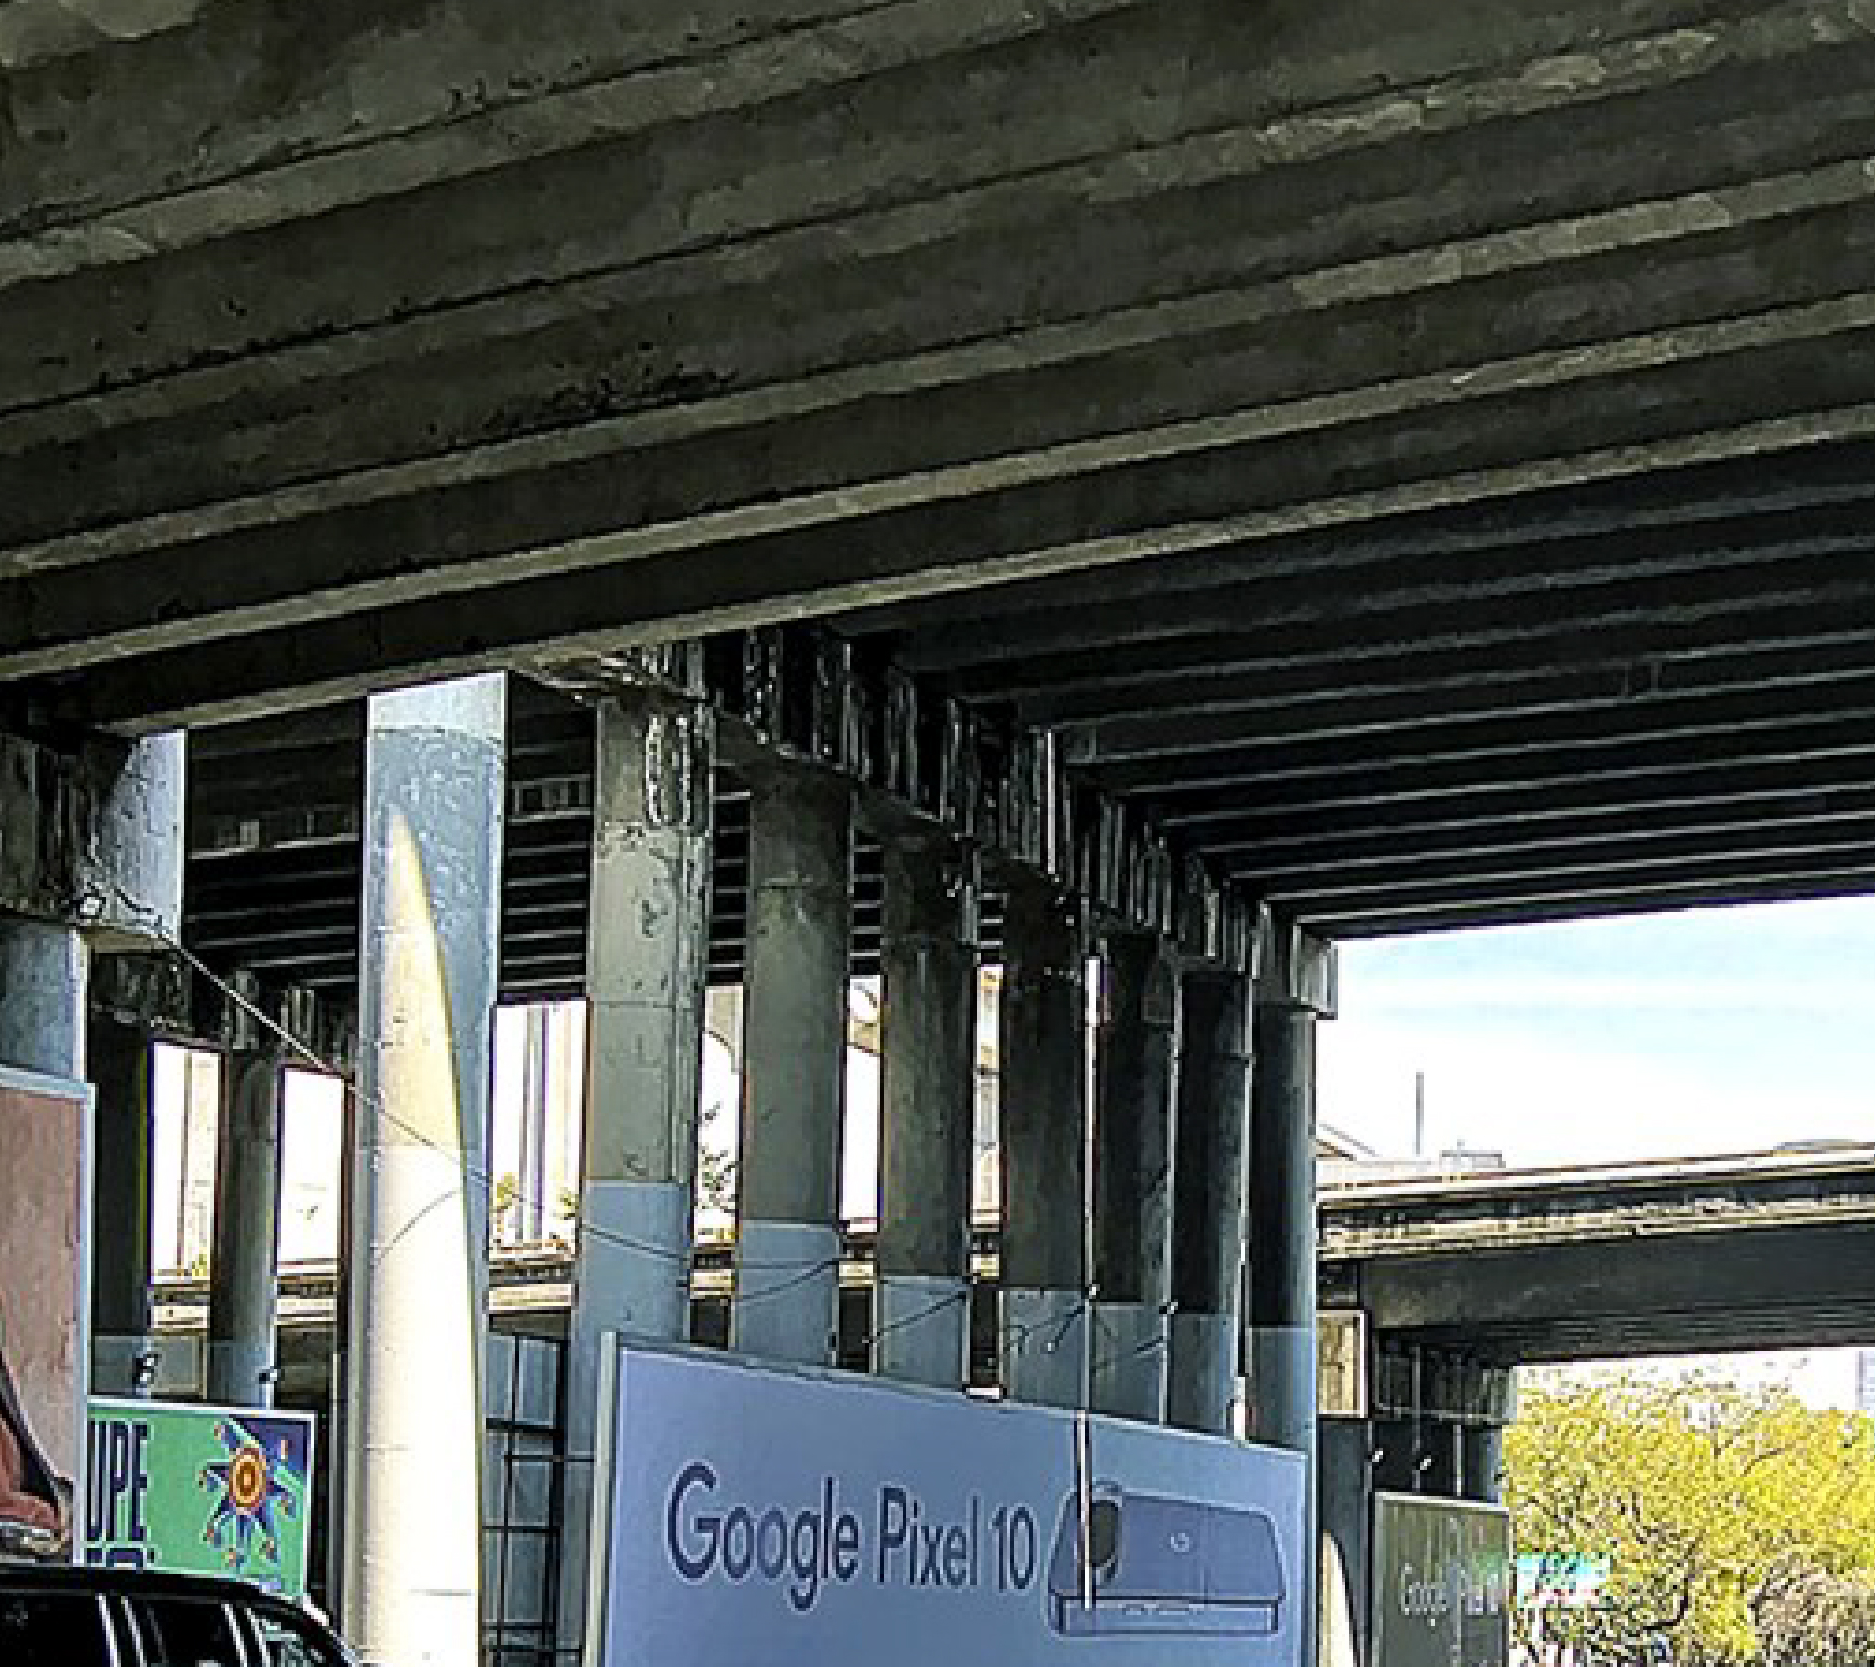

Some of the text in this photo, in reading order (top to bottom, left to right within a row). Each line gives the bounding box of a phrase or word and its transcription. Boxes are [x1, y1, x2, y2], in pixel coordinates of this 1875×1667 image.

[667, 1464, 1036, 1611] Google Pixel 10
